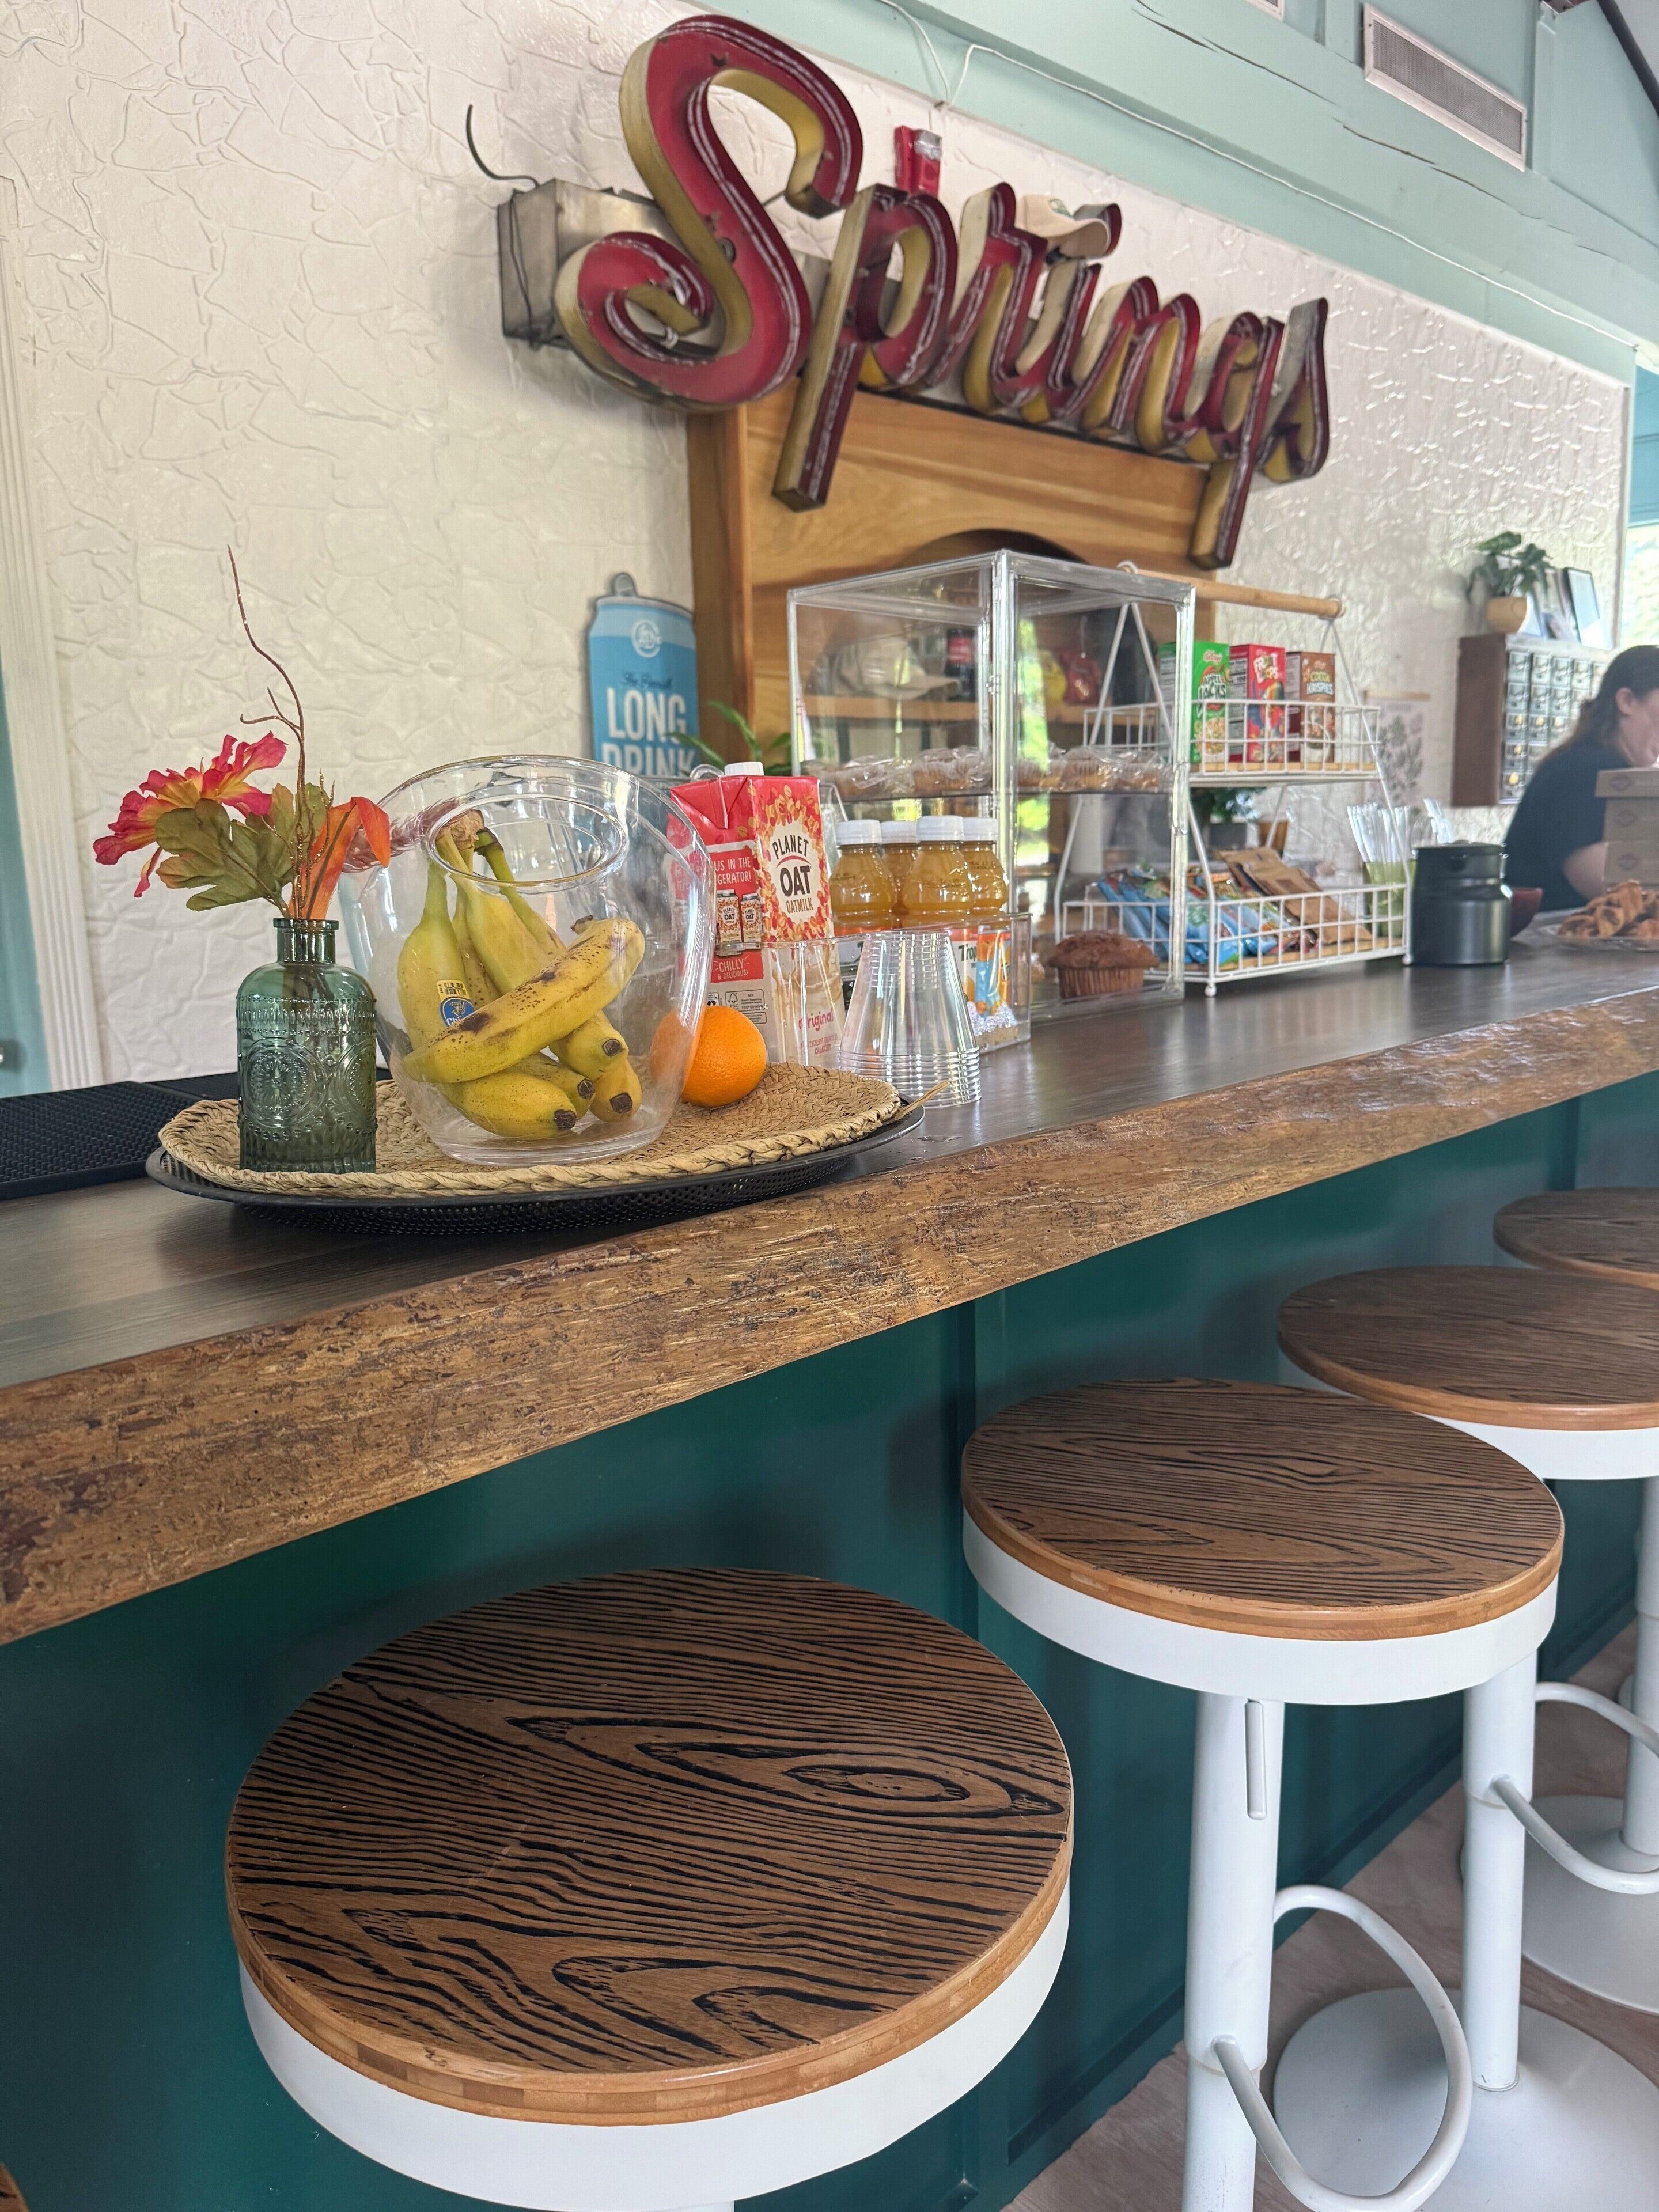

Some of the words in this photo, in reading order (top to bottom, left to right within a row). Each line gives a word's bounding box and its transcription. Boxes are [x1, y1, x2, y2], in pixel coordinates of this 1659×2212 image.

[607, 688, 687, 744] LONG
[772, 835, 809, 859] PLANET
[714, 860, 725, 872] US
[728, 859, 736, 870] IN
[738, 857, 751, 869] THE
[717, 871, 751, 885] GERATOR!
[786, 897, 813, 914] OATMILK
[718, 959, 744, 972] CHILLY
[724, 969, 748, 979] DELICIOUS!
